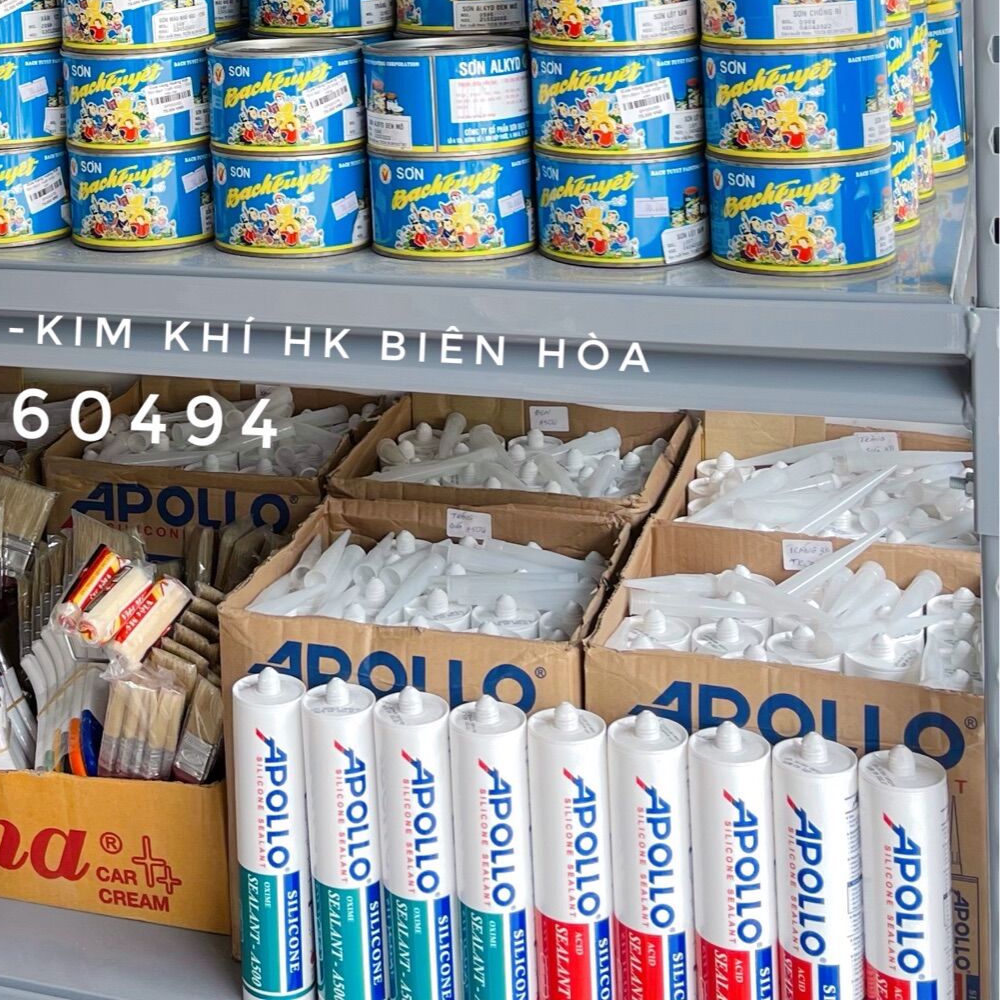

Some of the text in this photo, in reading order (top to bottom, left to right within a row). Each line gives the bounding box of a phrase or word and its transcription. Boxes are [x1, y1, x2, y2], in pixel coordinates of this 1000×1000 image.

[71, 64, 91, 77] SƠN
[228, 64, 250, 78] SƠN
[459, 56, 521, 76] SƠN ALKYD
[720, 60, 747, 75] SƠN
[396, 166, 424, 180] SƠN
[727, 172, 755, 188] SƠN
[71, 481, 290, 533] APOLLO
[248, 640, 536, 713] APOLLO
[629, 680, 965, 771] APOLLO
[255, 728, 290, 869] APOLLO
[256, 756, 267, 869] SILICONE SEALANT
[334, 739, 372, 883] APOLLO
[401, 749, 441, 897] APOLLO
[478, 758, 516, 908] APOLLO
[96, 866, 137, 886] CAR
[562, 768, 601, 918] APOLLO
[635, 776, 675, 930] APOLLO
[722, 788, 762, 946] APOLLO
[786, 794, 826, 958] APOLLO
[98, 889, 170, 912] CREAM
[247, 872, 262, 942] SEALANT
[263, 881, 271, 909] OXIME
[286, 890, 300, 974] SILICONE
[882, 812, 925, 975] APOLLO
[369, 900, 382, 986] SILICONE
